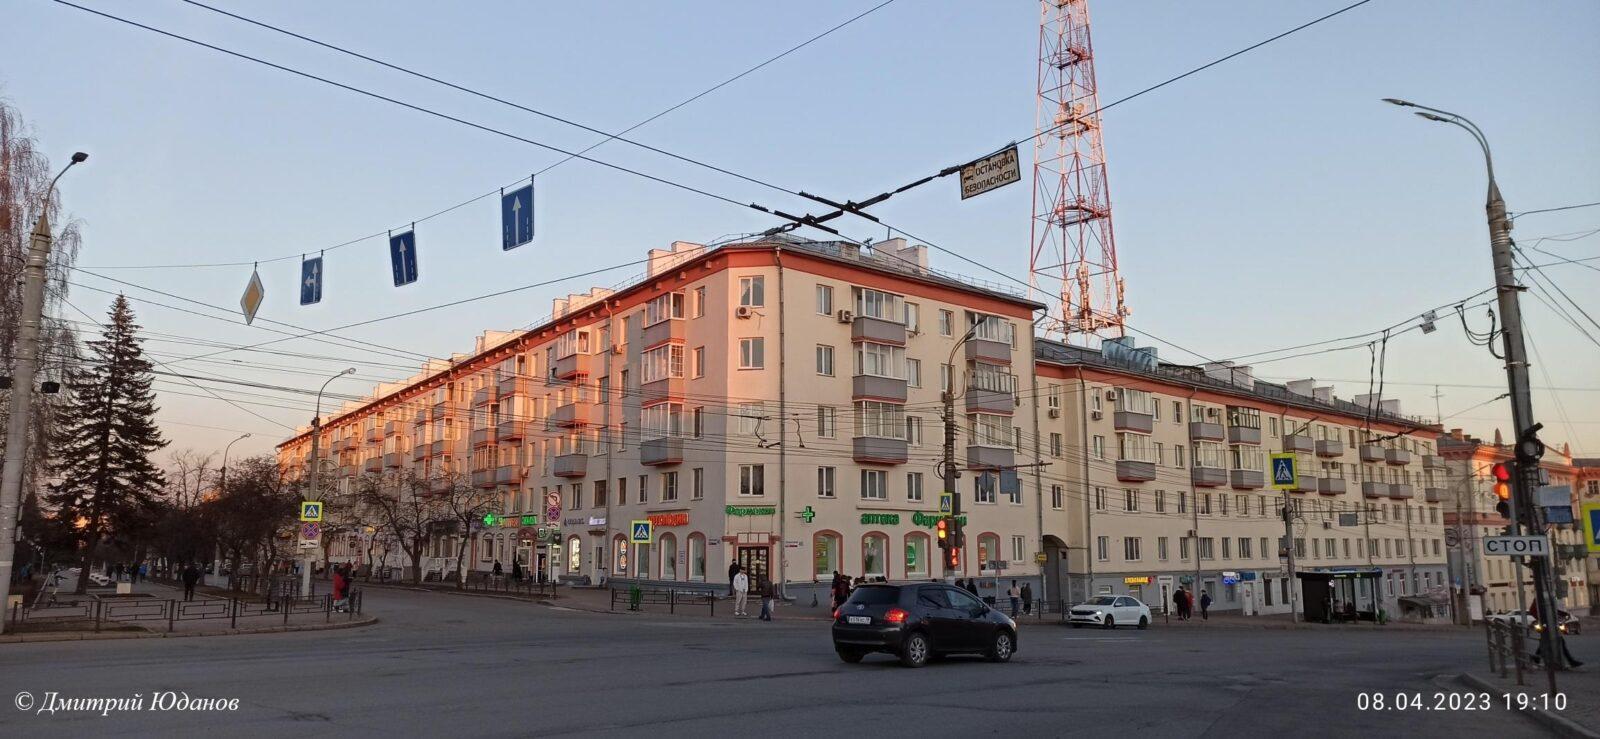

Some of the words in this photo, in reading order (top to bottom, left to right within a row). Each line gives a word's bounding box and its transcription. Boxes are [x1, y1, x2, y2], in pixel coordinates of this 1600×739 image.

[975, 154, 1015, 176] ОСТАНОВКА
[964, 169, 1017, 194] БЕЗОПАСНОСТИ
[860, 513, 900, 526] аптека
[1487, 540, 1542, 552] СТОП
